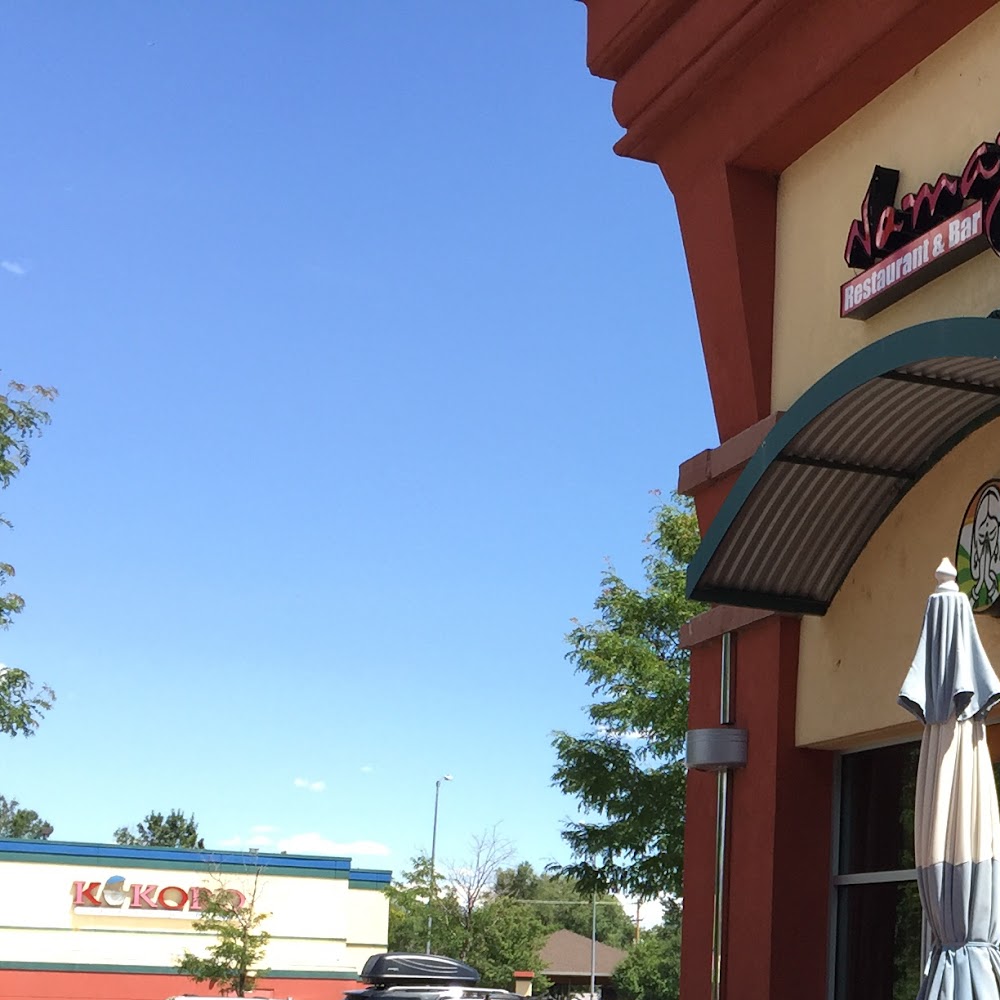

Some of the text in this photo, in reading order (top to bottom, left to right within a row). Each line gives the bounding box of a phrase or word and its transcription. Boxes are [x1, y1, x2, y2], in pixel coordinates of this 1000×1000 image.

[844, 209, 981, 311] Restaurant & Bar
